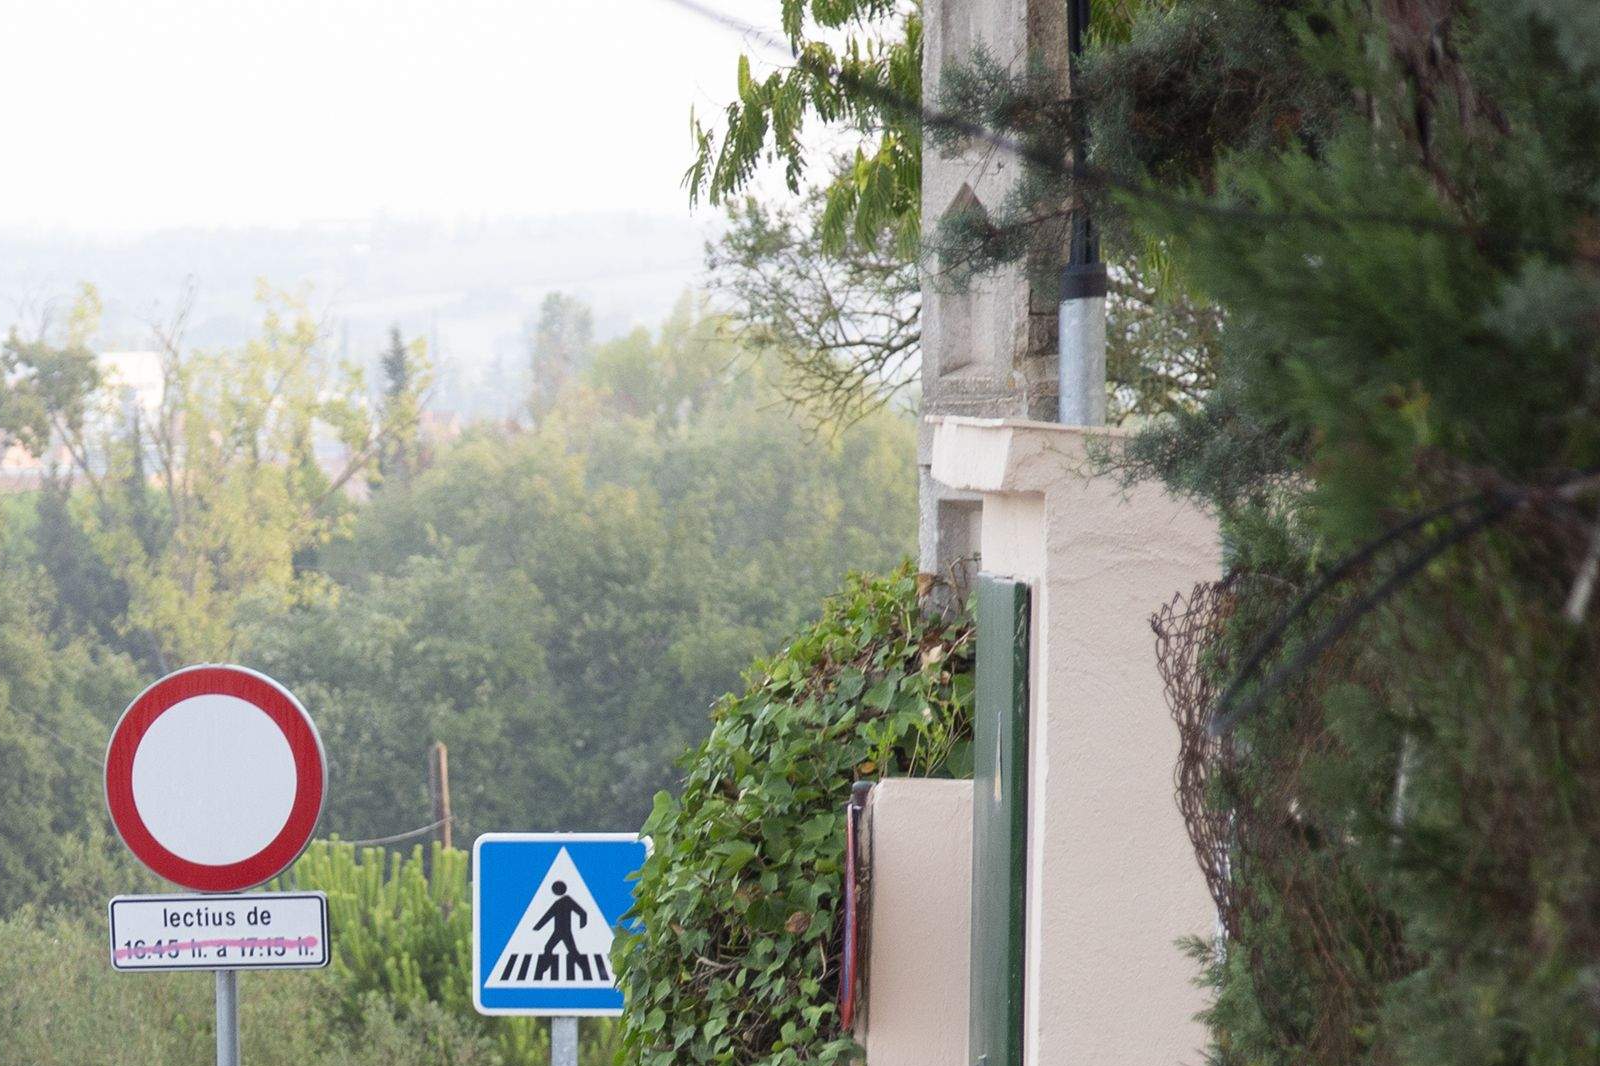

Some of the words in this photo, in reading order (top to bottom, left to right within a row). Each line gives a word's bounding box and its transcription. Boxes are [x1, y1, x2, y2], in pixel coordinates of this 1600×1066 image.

[163, 907, 236, 927] lectius
[246, 906, 272, 926] de
[216, 943, 227, 957] a
[240, 936, 286, 957] 17:15
